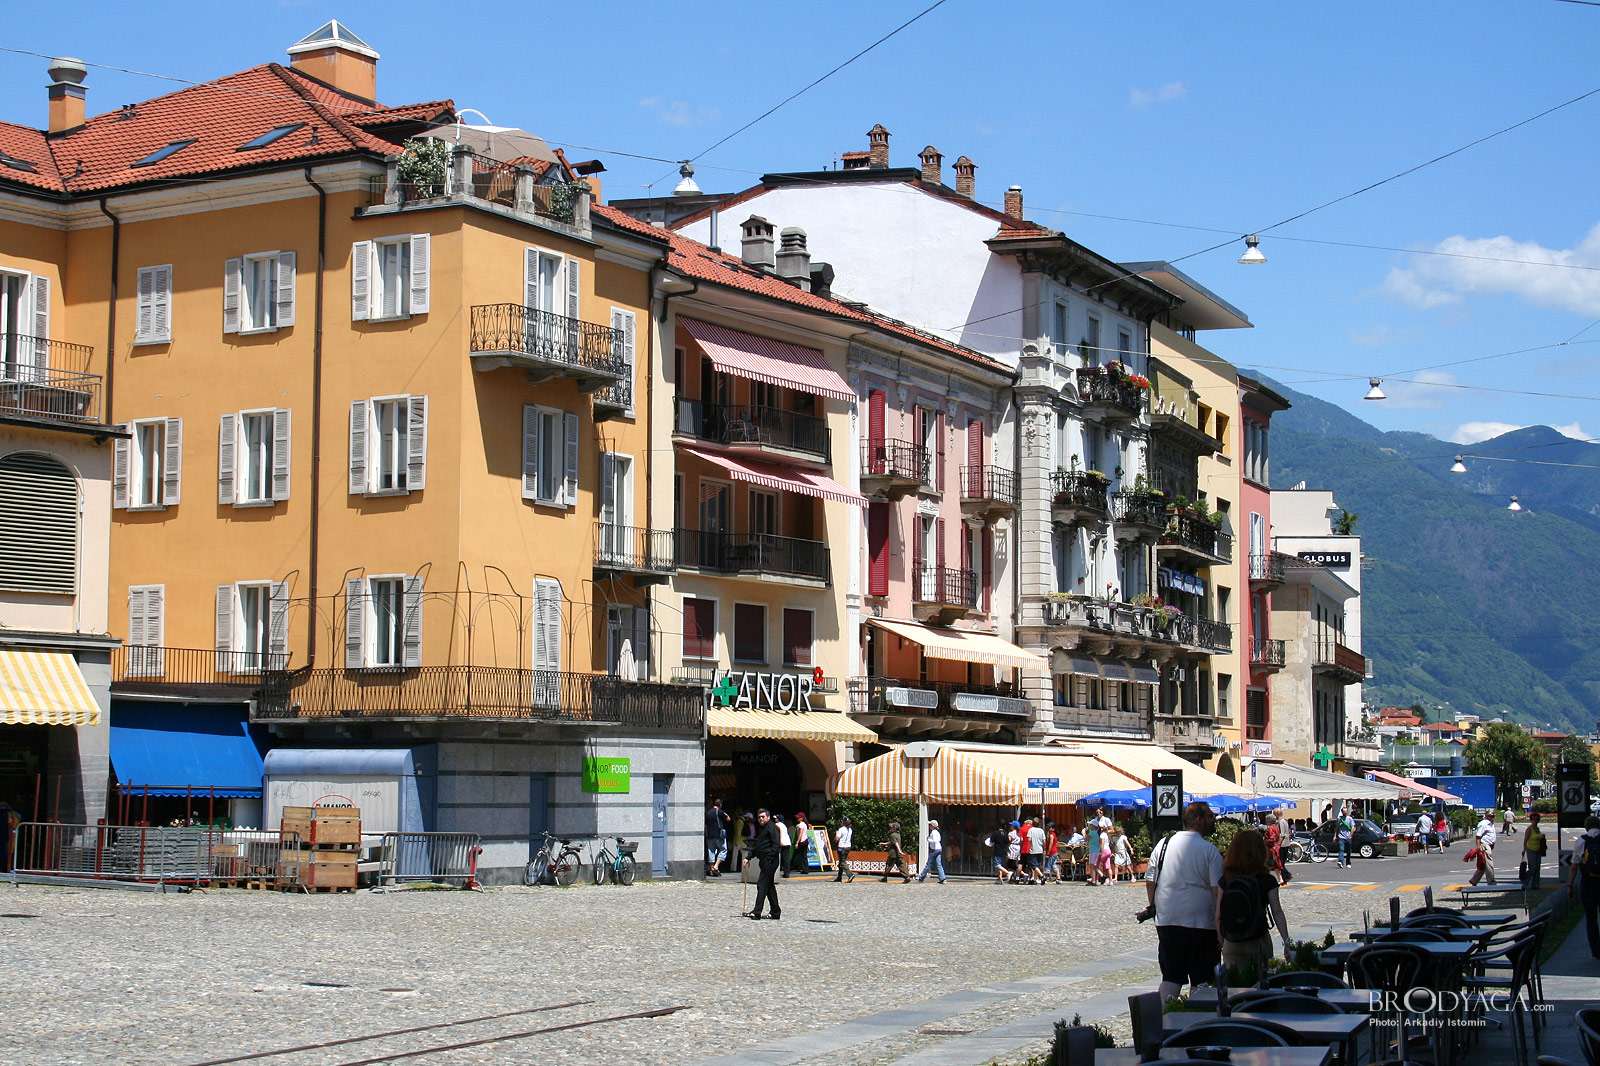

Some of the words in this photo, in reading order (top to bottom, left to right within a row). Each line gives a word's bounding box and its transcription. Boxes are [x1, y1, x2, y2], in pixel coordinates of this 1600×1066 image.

[740, 754, 778, 763] MANOR
[611, 764, 628, 773] FOOD
[1266, 774, 1303, 789] Ravelli
